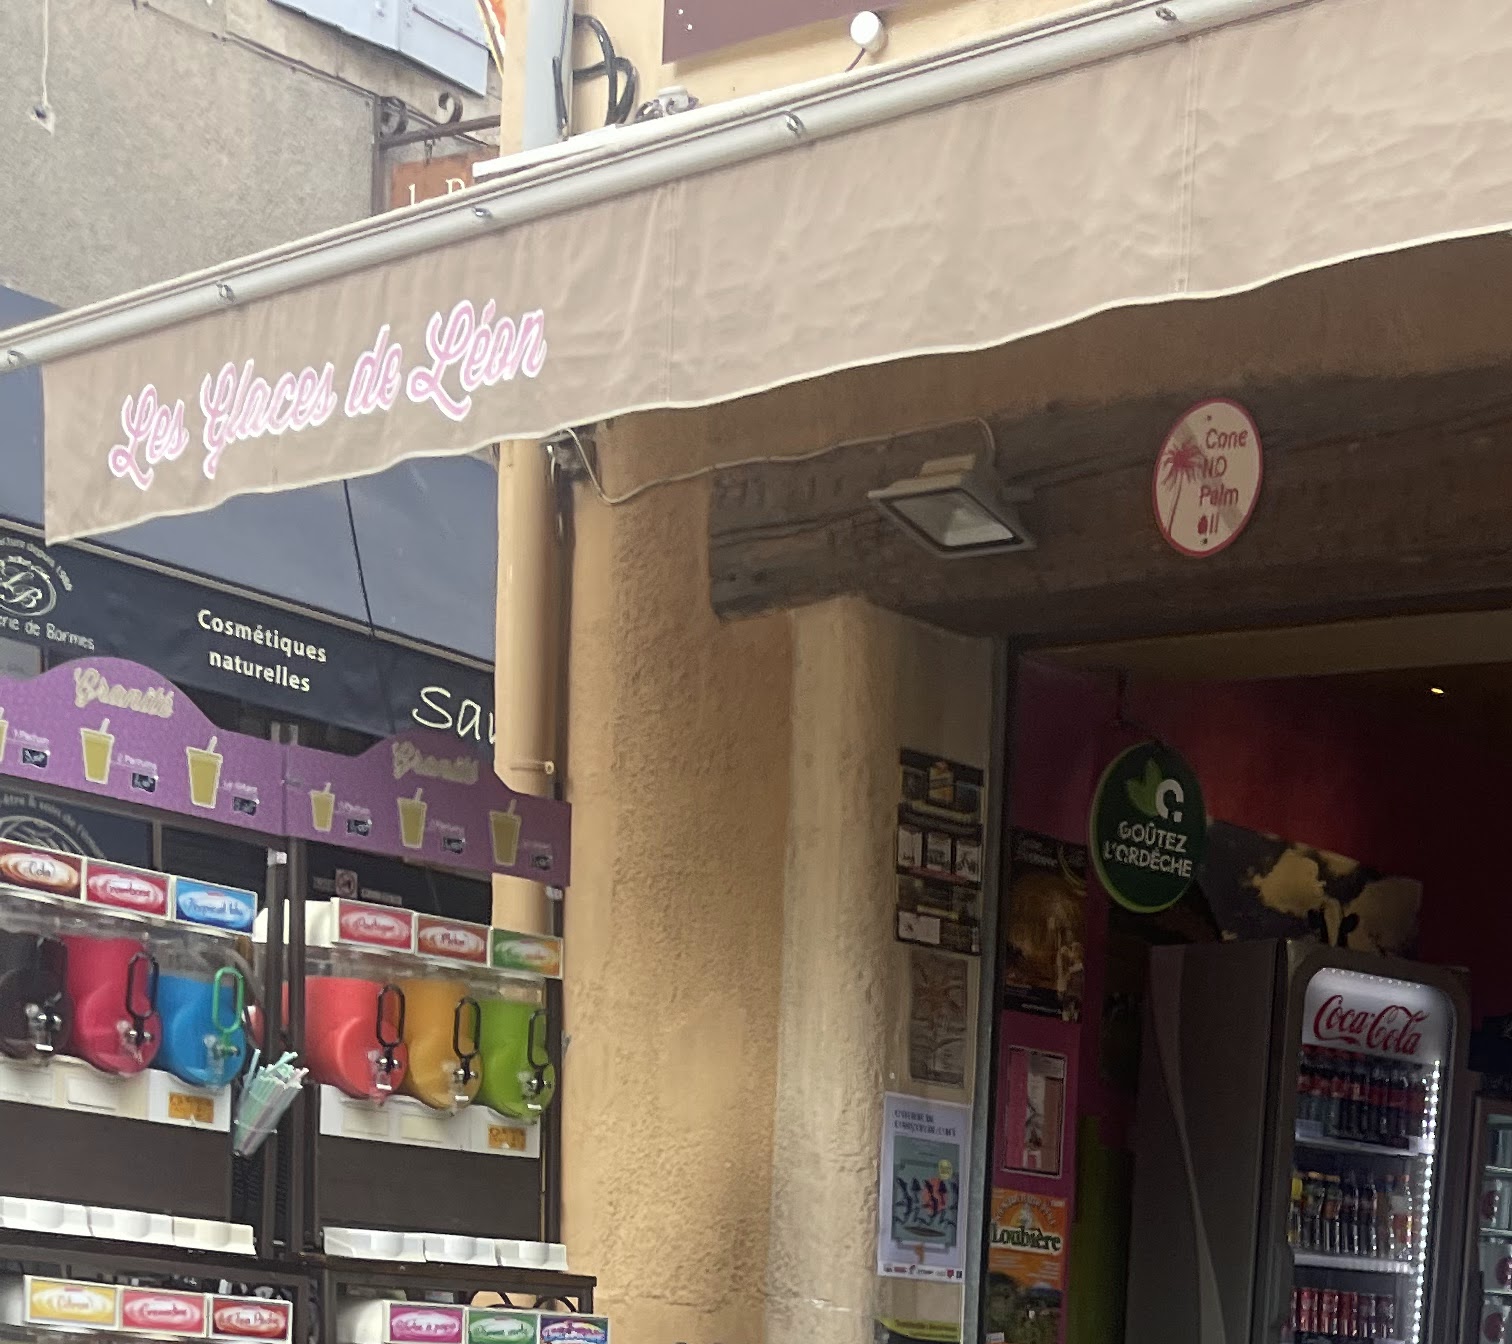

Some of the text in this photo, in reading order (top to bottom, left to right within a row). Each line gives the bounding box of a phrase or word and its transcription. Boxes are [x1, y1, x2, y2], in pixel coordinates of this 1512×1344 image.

[109, 298, 548, 489] Les Glaces de Léon
[197, 609, 327, 662] Cosmétiques
[209, 651, 310, 691] naturelles
[1118, 821, 1188, 853] GOÛTEZ
[1313, 994, 1430, 1056] Coca-Cola
